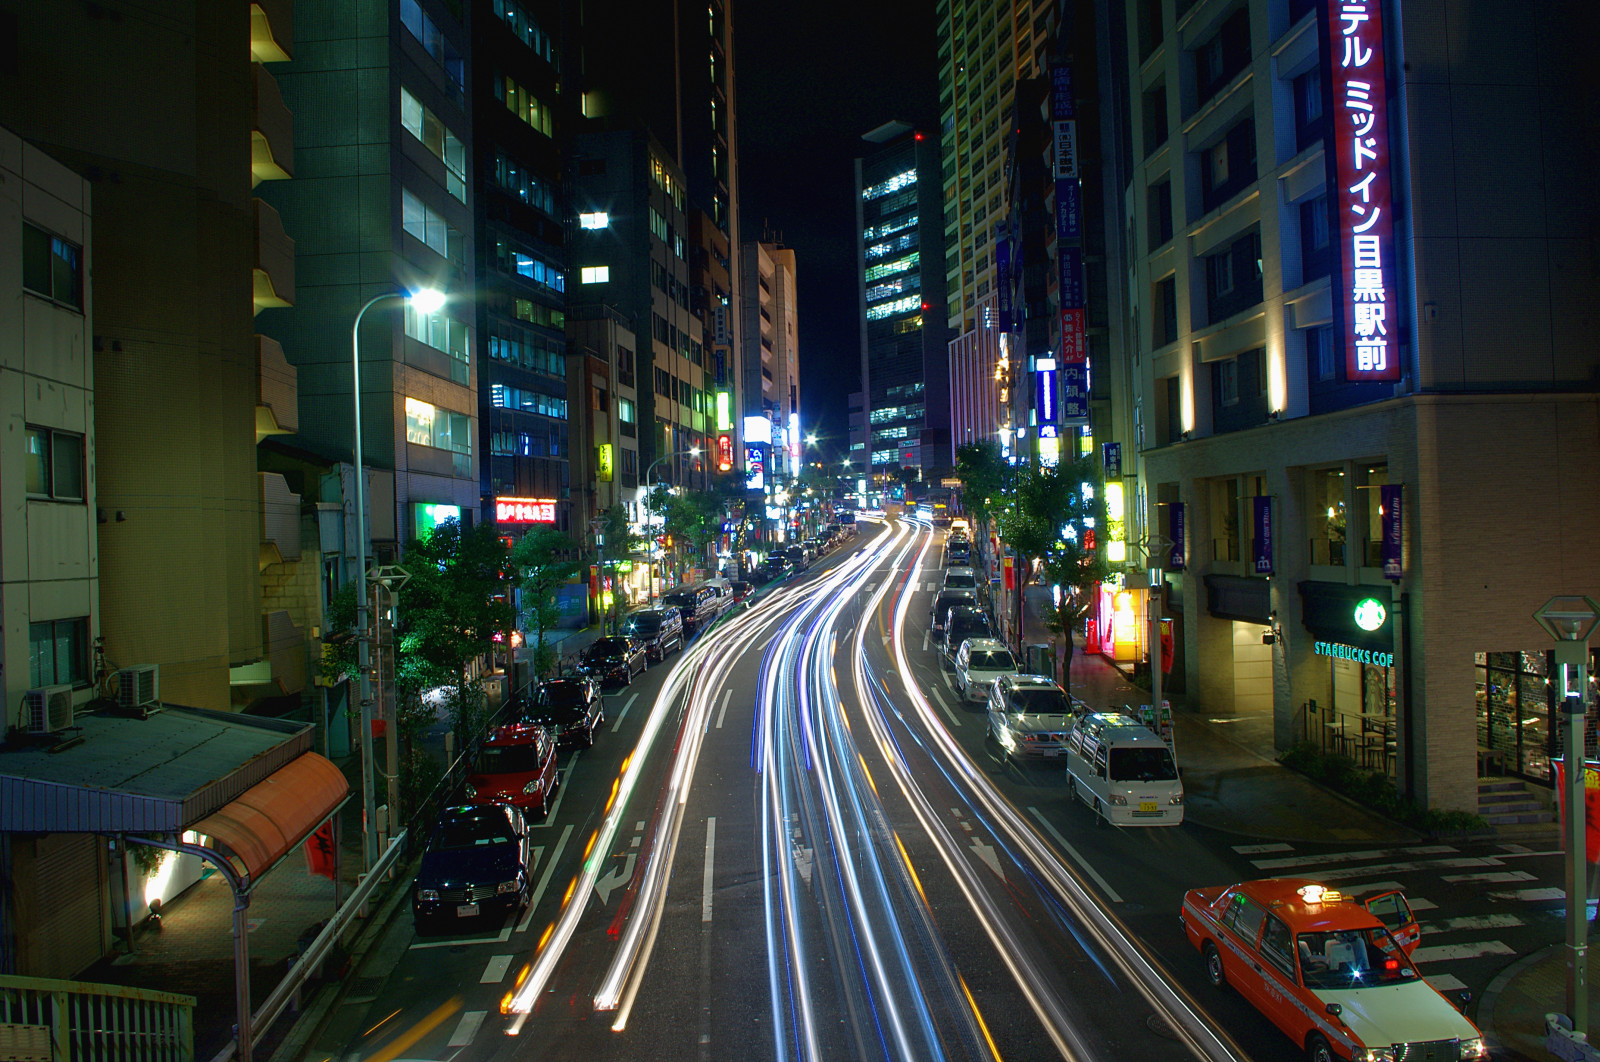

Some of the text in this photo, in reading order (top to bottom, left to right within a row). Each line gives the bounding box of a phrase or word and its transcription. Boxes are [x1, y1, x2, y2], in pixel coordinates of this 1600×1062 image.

[1345, 79, 1388, 372] ミッドイン目黒駅前
[1314, 641, 1370, 665] STARBUCKS
